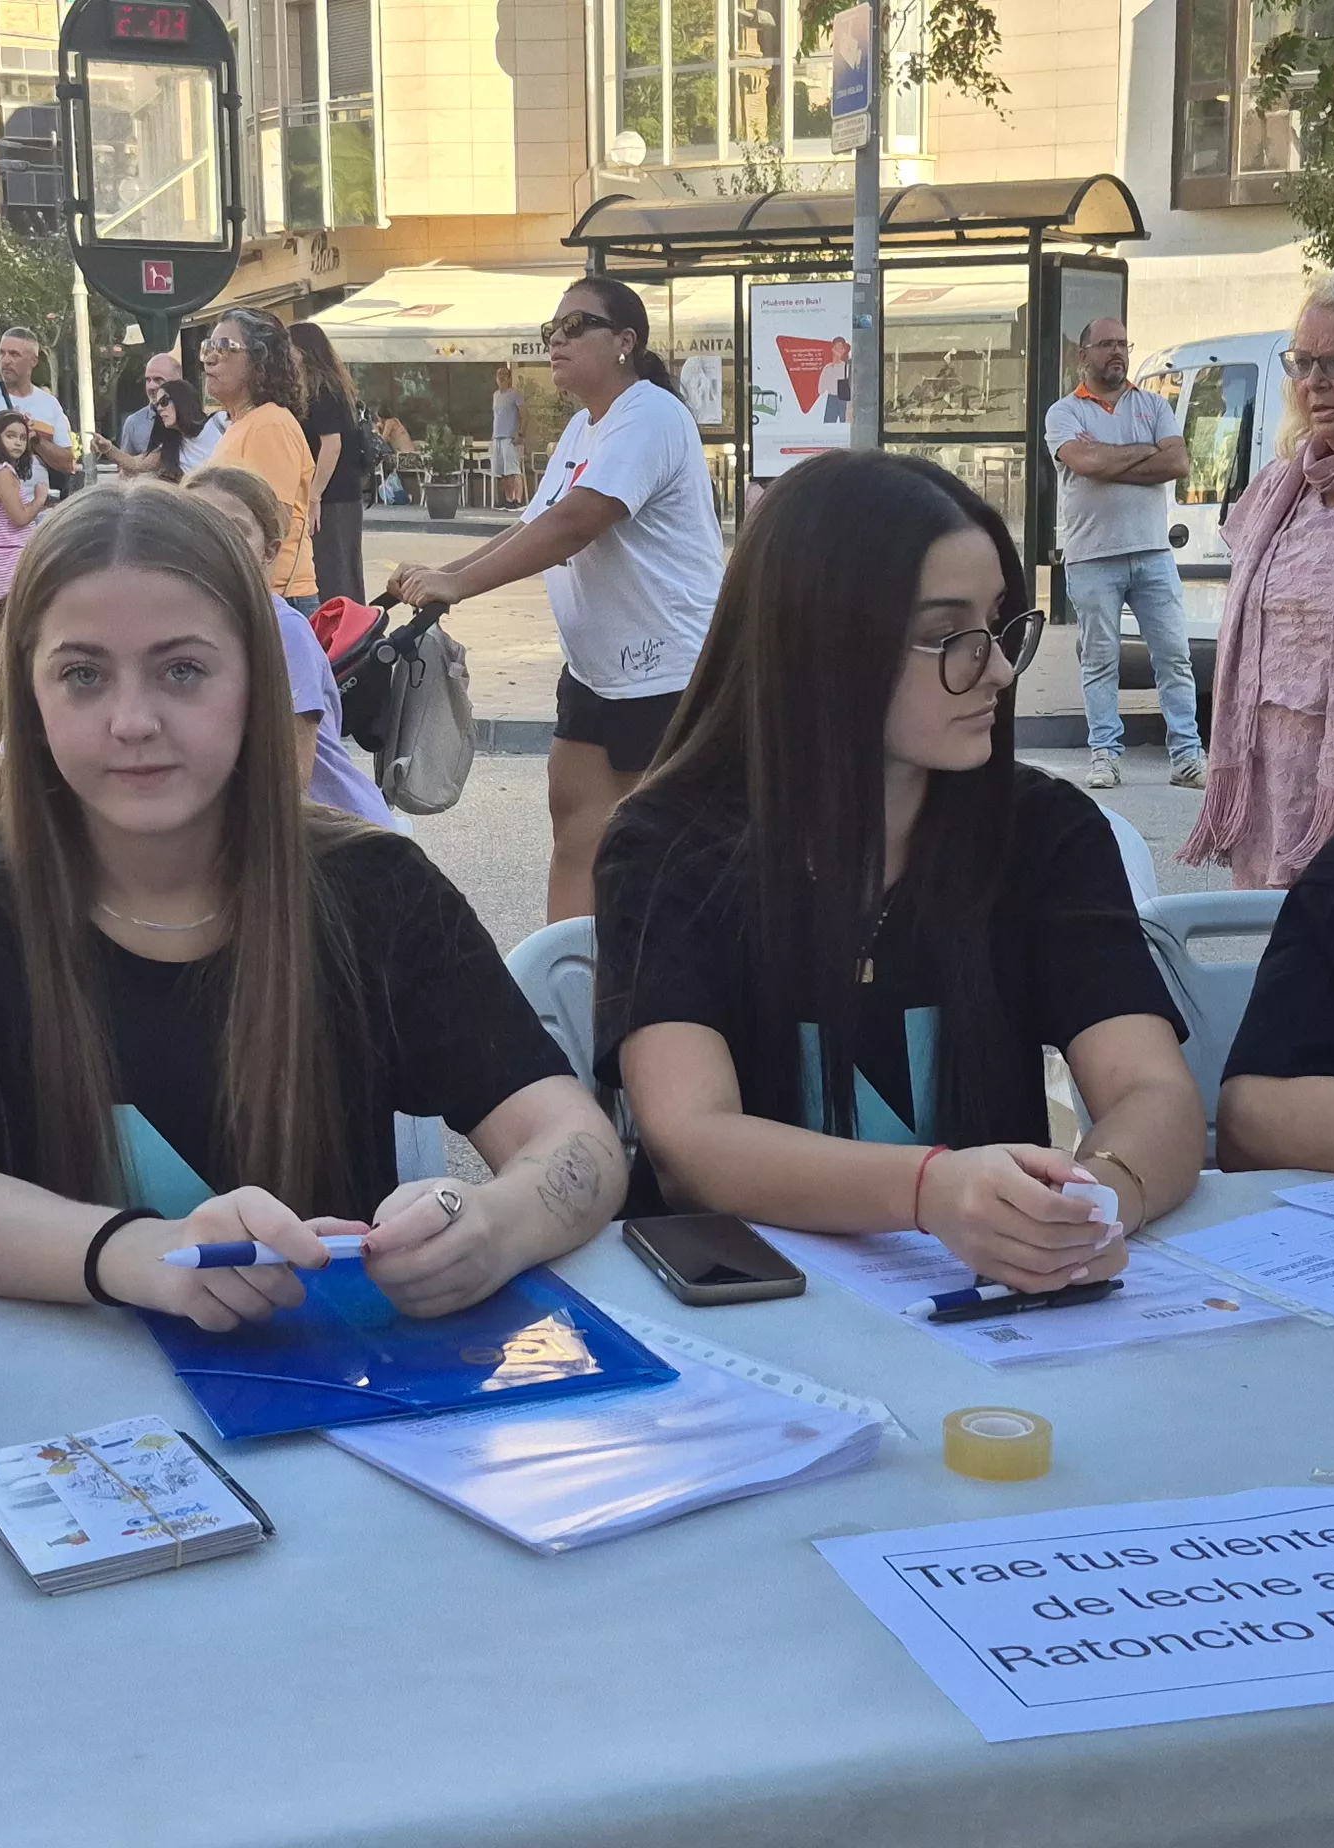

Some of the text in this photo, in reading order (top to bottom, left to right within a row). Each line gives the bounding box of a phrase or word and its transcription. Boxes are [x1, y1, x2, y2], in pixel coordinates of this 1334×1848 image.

[512, 343, 551, 355] RESTA
[689, 339, 734, 352] ANITA
[903, 1552, 1047, 1592] Trae
[1053, 1543, 1159, 1573] tus
[1032, 1596, 1115, 1621] de
[1119, 1576, 1303, 1611] leche
[987, 1619, 1315, 1673] Ratoncito
